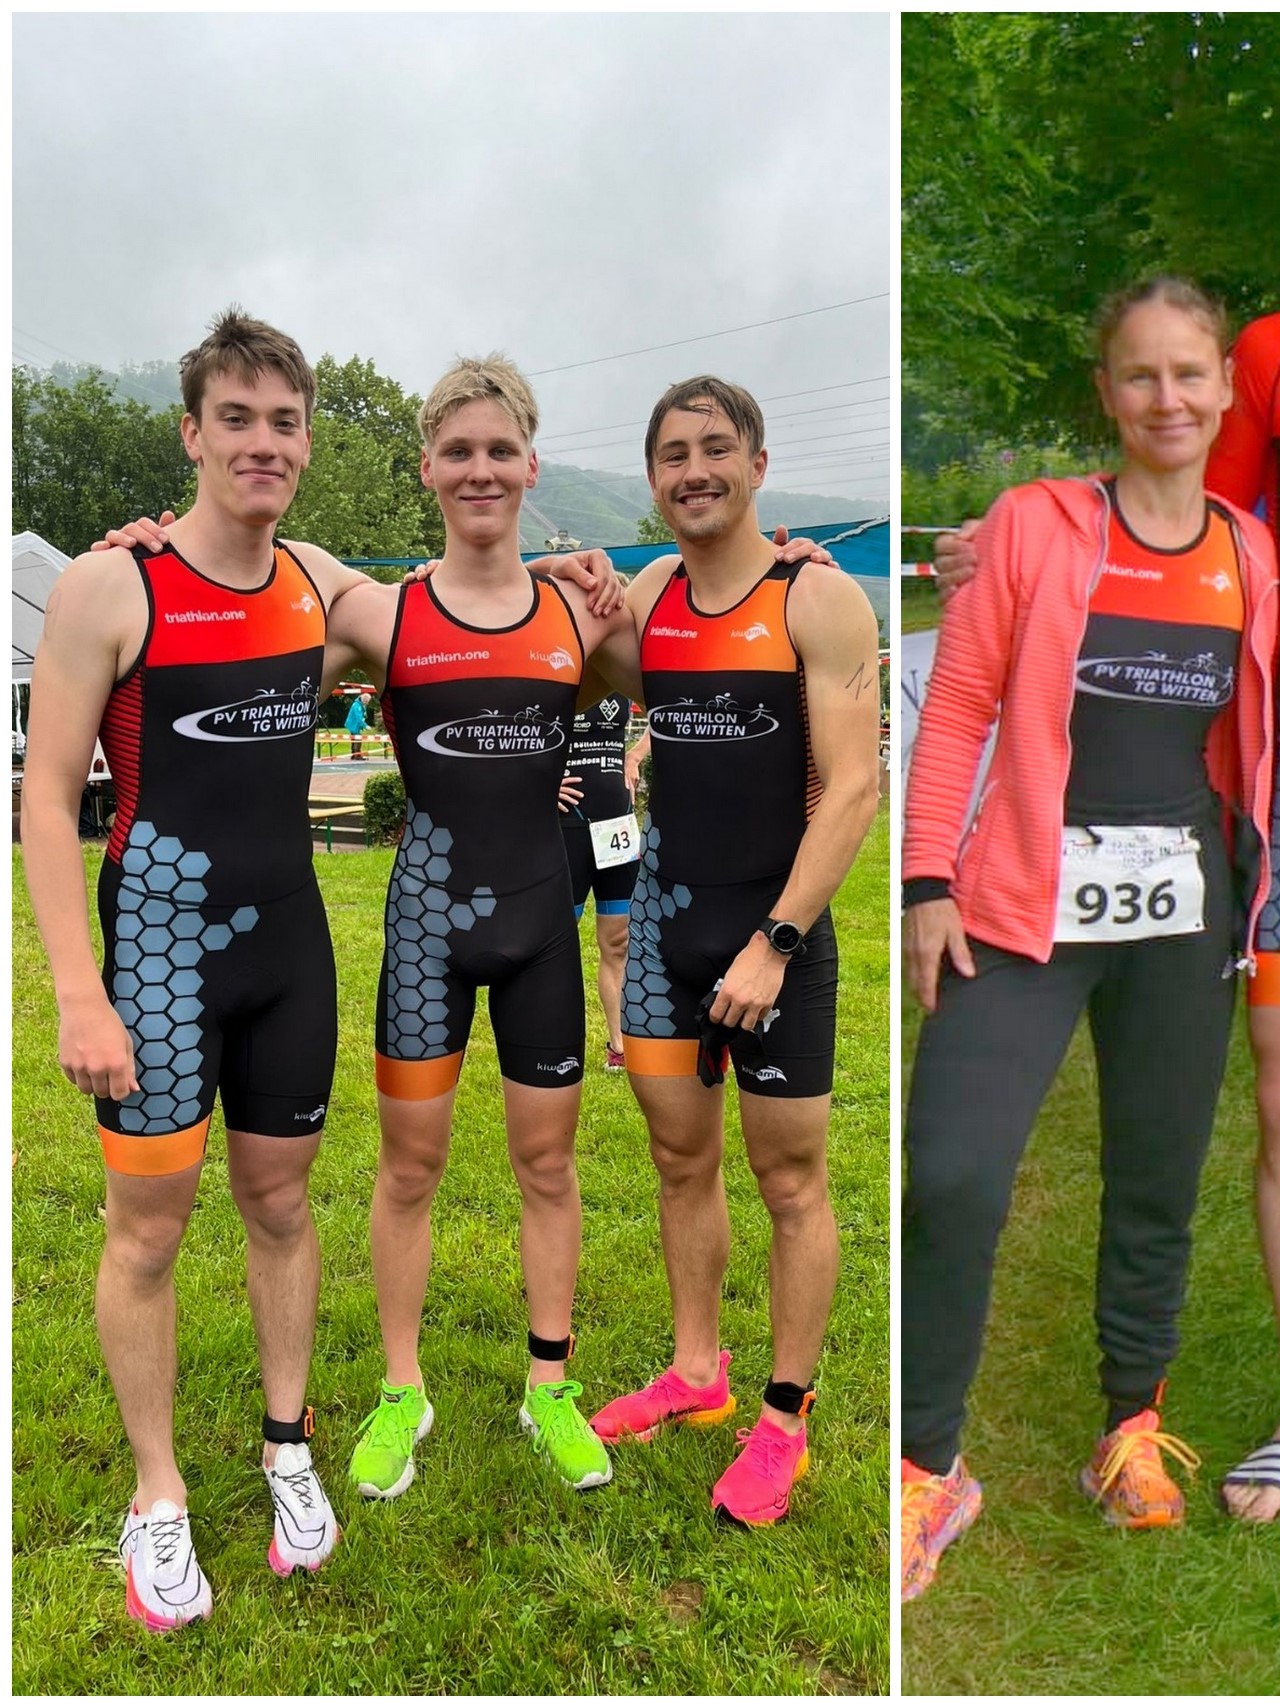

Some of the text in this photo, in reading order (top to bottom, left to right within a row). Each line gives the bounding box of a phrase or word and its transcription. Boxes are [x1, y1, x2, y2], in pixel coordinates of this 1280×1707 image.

[164, 609, 247, 624] triathlon.one
[406, 650, 490, 668] triathlon.one
[529, 648, 572, 668] kiwami
[1094, 663, 1216, 687] PV TRIATHLON
[1134, 680, 1219, 702] TG WITTEN
[213, 699, 311, 726] PV TRIATHLON
[653, 712, 738, 724] PV TRIATHLON
[252, 713, 313, 734] TG WITTEN
[446, 725, 542, 739] PV TRIATHLON
[675, 723, 746, 737] TG WITTEN
[477, 738, 546, 750] TG WITTEN
[610, 830, 631, 851] 43
[1075, 878, 1177, 925] 936
[536, 1058, 578, 1073] kiwami
